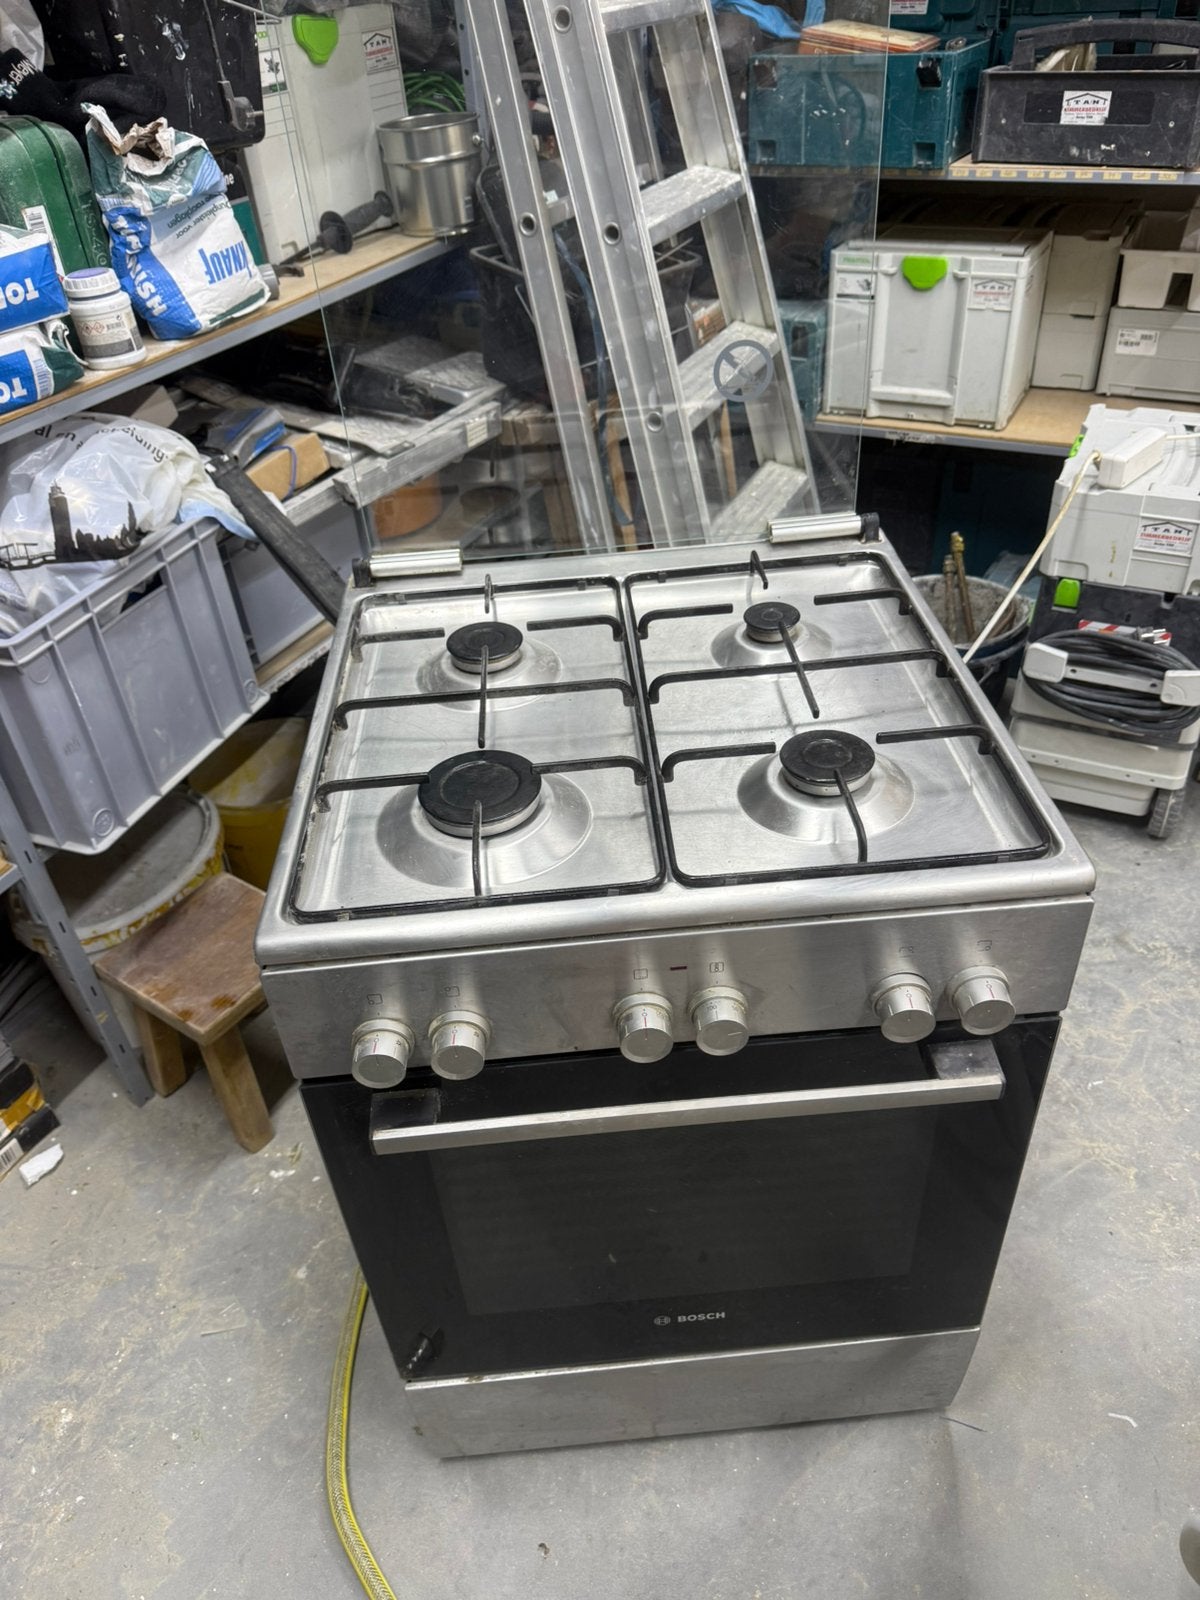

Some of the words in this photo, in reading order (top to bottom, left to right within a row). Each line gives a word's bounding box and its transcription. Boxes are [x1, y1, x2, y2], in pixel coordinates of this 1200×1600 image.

[175, 224, 194, 240] voor
[198, 240, 253, 285] KNAUF
[1152, 526, 1182, 534] TAN
[677, 1311, 726, 1323] BOSCH
